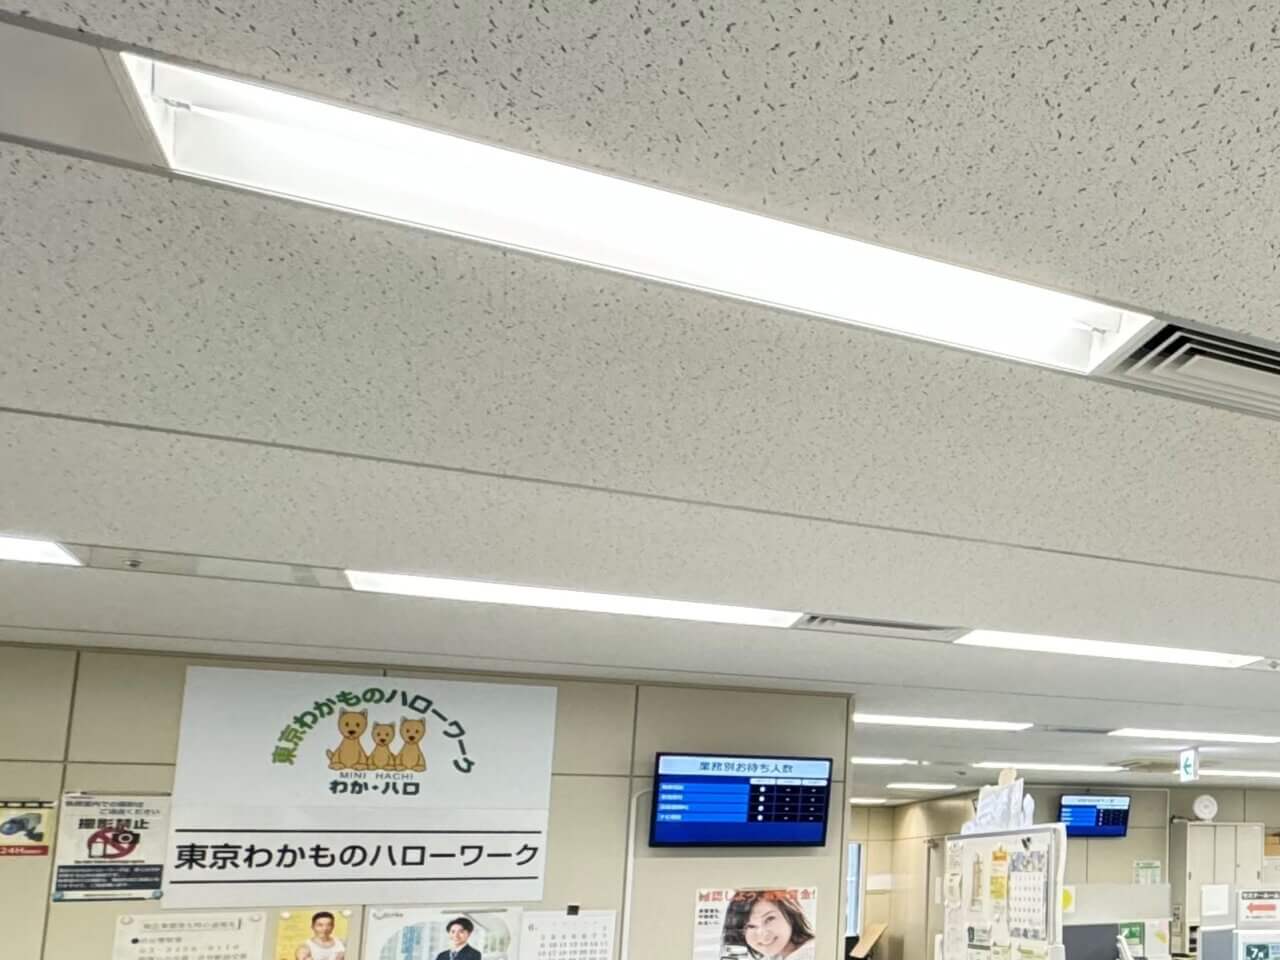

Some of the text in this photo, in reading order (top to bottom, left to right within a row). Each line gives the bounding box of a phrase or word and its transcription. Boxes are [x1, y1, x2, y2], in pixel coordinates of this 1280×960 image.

[272, 687, 475, 774] 東京わかものハローワーク
[700, 761, 794, 774] 業務別お待ち人数
[330, 780, 420, 796] わか・ハロ
[174, 843, 539, 870] 東京わかものハローワーク
